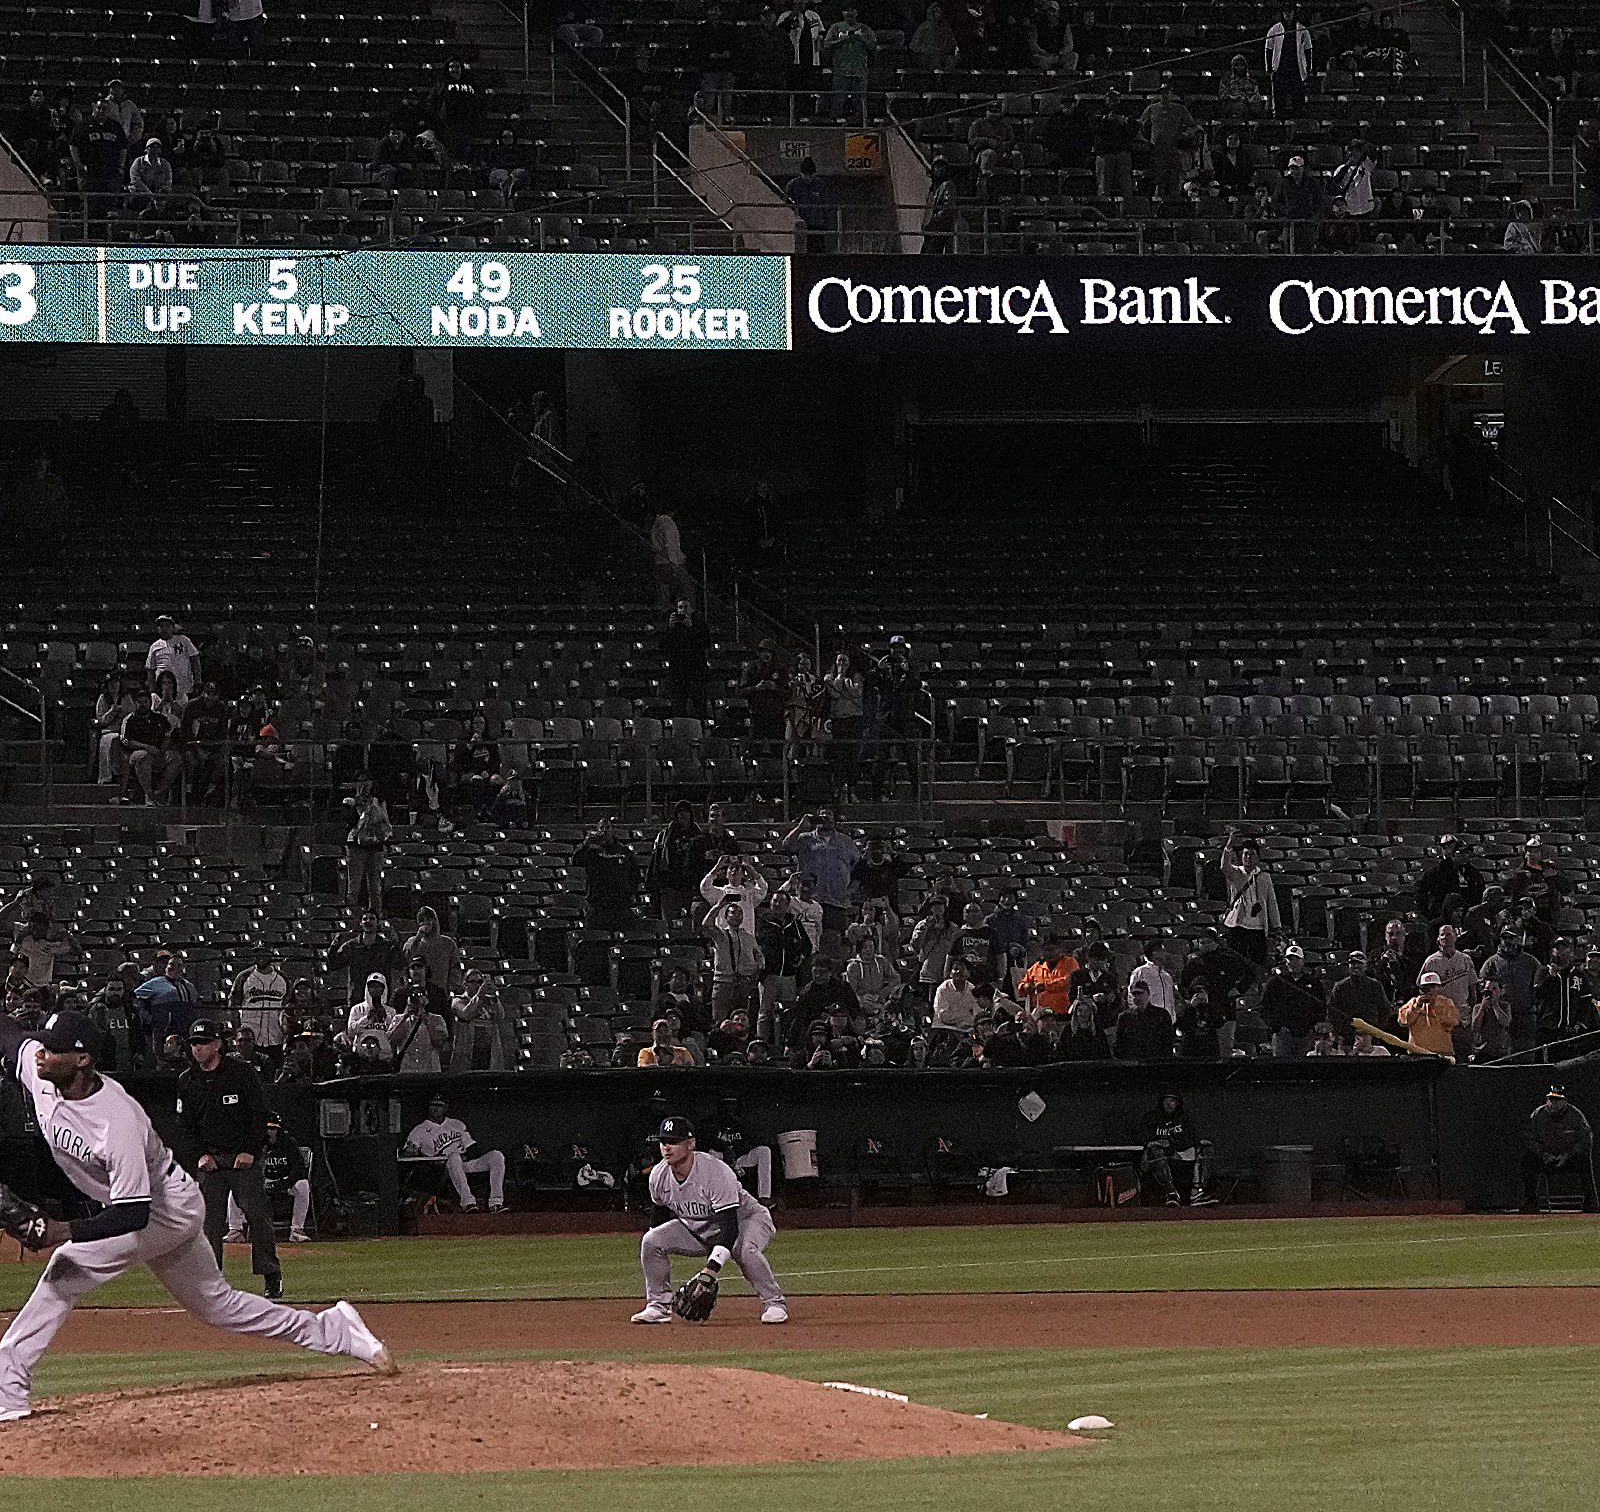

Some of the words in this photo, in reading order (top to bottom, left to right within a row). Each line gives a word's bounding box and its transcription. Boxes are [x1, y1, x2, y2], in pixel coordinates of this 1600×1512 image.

[128, 263, 200, 289] DUE
[267, 260, 298, 299] 5
[446, 262, 512, 303] 49
[641, 265, 701, 304] 25
[144, 308, 192, 334] UP
[233, 303, 350, 337] KEMP
[431, 307, 541, 338] NODA
[609, 308, 751, 341] ROOKER
